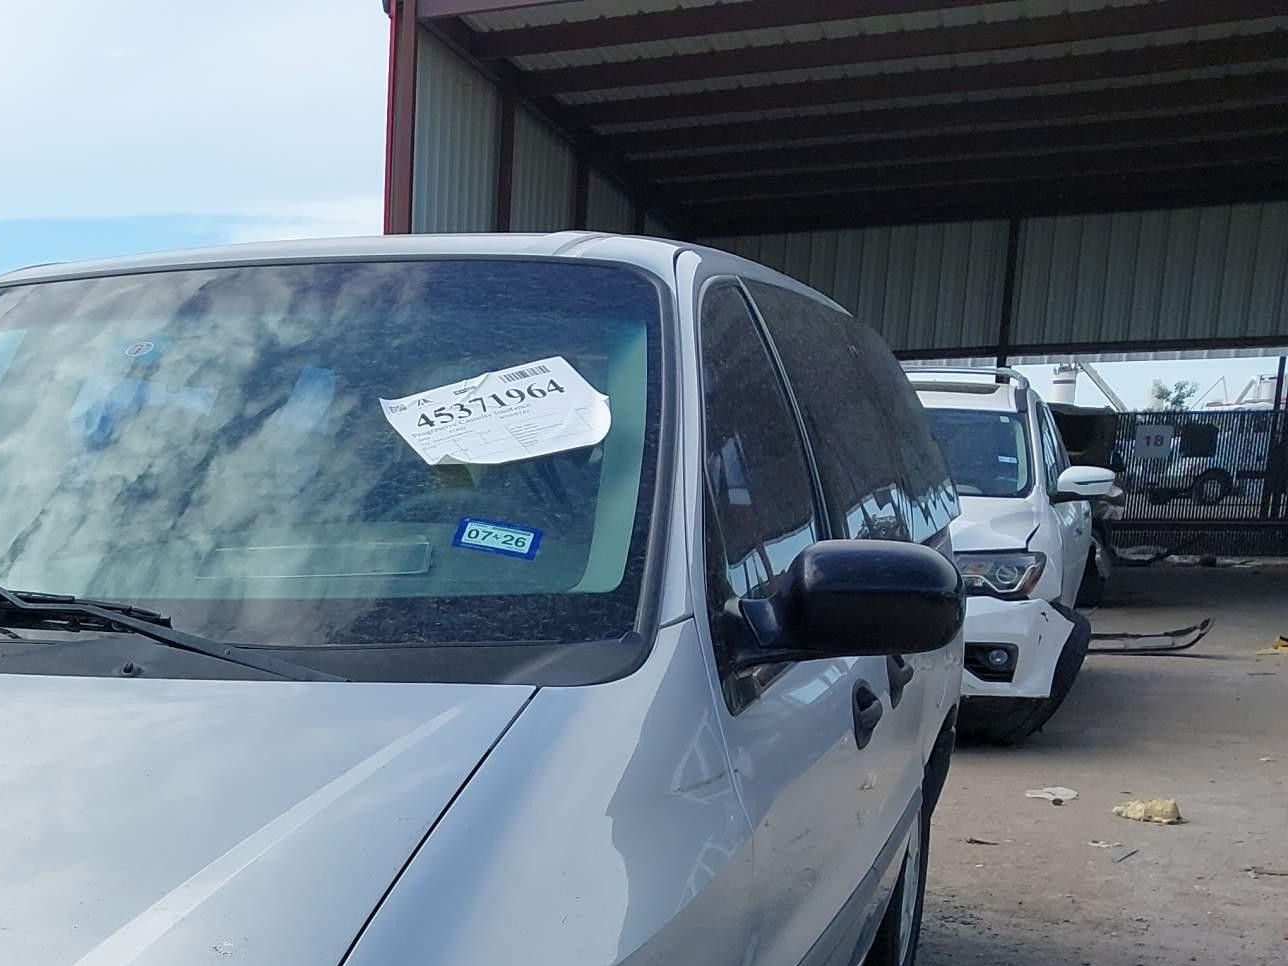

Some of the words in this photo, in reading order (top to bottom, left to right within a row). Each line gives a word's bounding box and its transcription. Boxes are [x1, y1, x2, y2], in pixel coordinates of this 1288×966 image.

[416, 378, 566, 429] 45371964
[1144, 434, 1165, 447] 18
[467, 528, 493, 541] 07
[501, 534, 527, 548] 26
